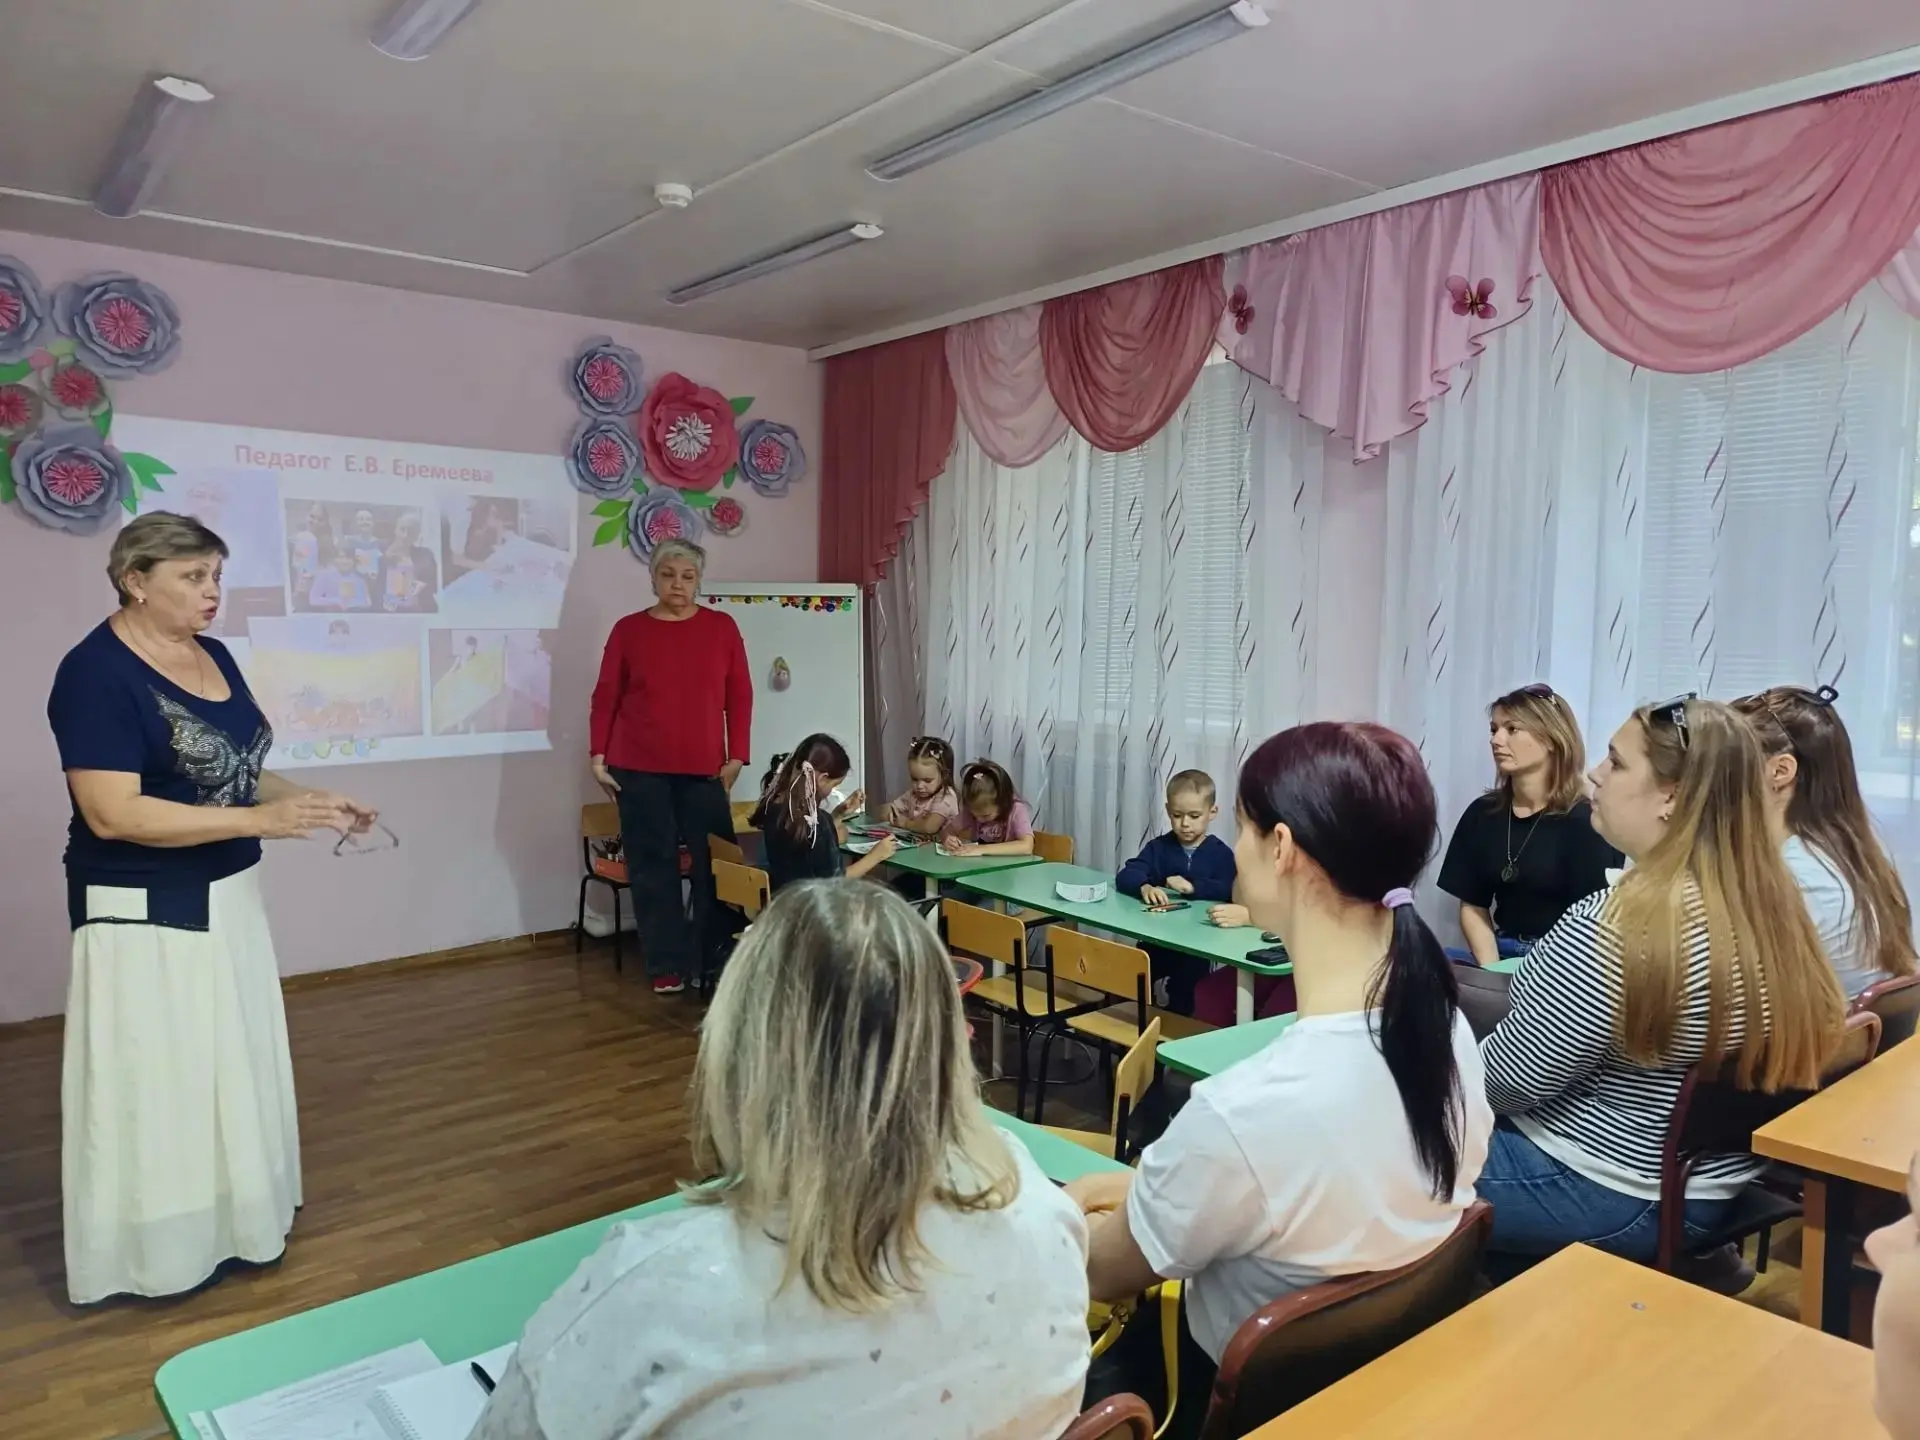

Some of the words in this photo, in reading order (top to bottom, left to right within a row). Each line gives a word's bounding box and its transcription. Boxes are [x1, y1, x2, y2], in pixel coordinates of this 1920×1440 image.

[235, 444, 332, 471] Педагог
[344, 454, 385, 474] Е.В.
[392, 458, 494, 484] Еремеева
